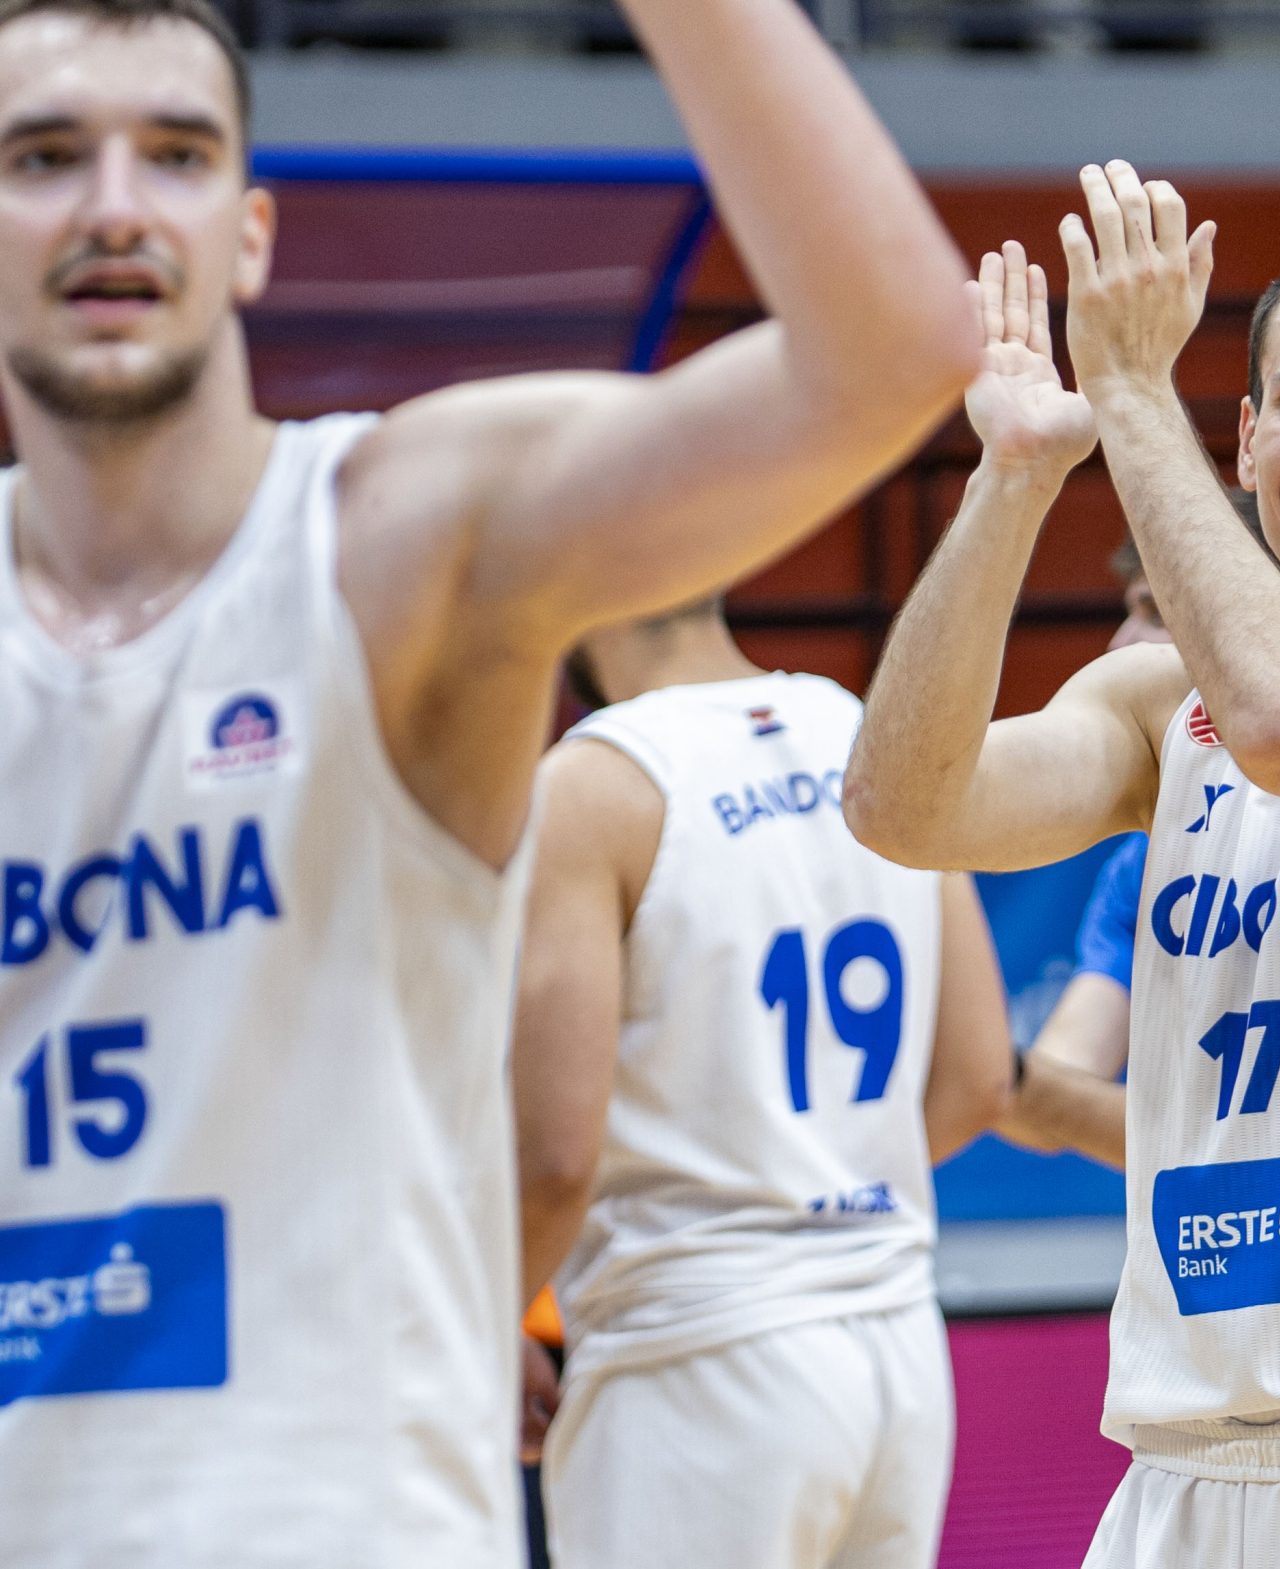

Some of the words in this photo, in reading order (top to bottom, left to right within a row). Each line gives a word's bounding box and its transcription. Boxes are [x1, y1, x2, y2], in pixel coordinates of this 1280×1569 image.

[758, 915, 905, 1114] 19
[15, 1017, 148, 1170] 15
[1178, 1206, 1277, 1251] ERSTE
[1178, 1254, 1228, 1278] Bank
